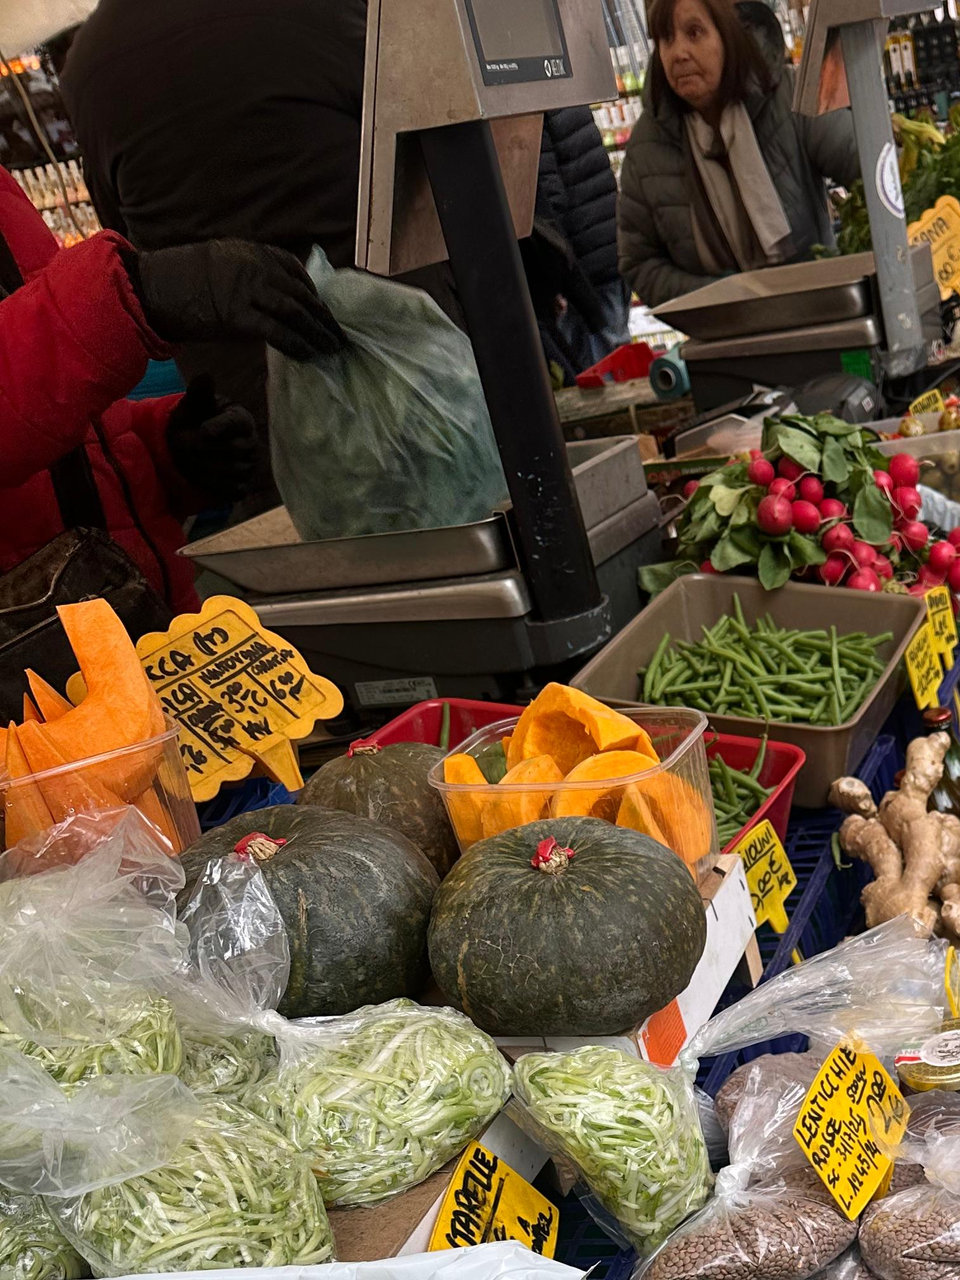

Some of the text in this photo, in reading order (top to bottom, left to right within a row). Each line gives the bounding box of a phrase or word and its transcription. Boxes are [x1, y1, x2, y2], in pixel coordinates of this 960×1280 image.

[742, 826, 773, 871] IOLINI
[768, 850, 783, 874] €
[796, 1046, 858, 1149] LENTICCHIE
